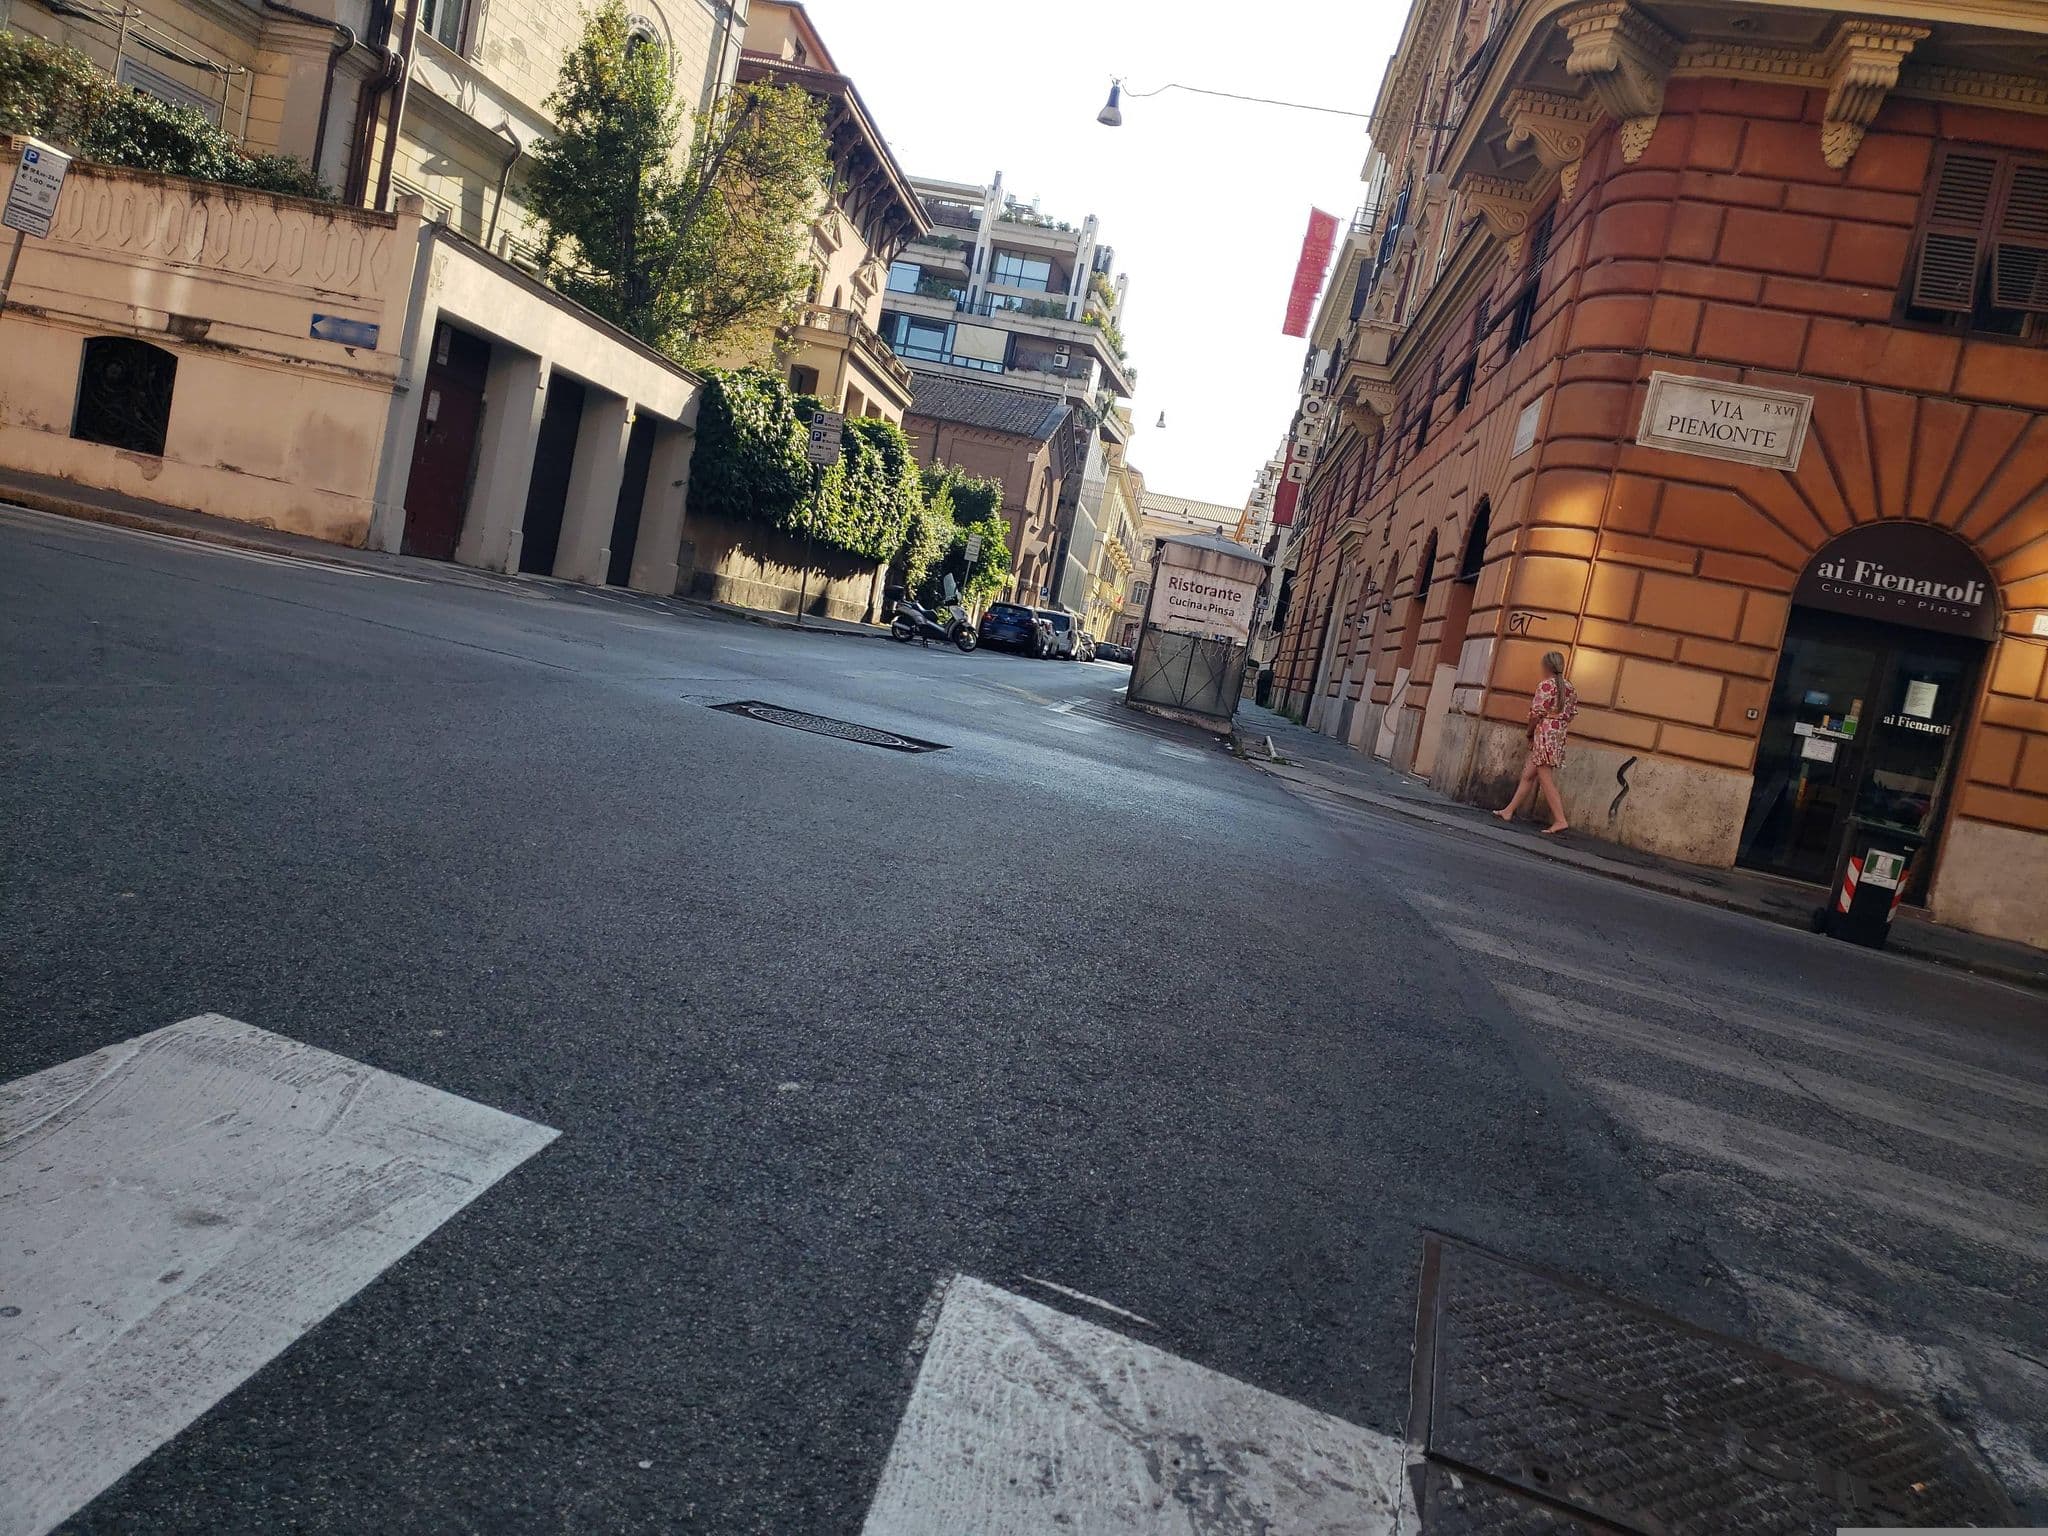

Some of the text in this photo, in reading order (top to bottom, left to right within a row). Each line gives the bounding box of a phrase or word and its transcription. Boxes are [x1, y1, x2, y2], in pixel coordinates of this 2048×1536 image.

[1710, 399, 1745, 421] VIA
[1292, 378, 1326, 480] HOTEL
[1667, 415, 1777, 449] PIEMONTE
[1168, 576, 1242, 603] Ristorante
[1817, 557, 1986, 605] ai Fienaroli
[1169, 595, 1203, 611] Cucina
[1208, 603, 1235, 617] Pinsa
[1821, 583, 1972, 618] Cucina e Pinsa
[1883, 714, 1953, 736] ai Fienaroli
